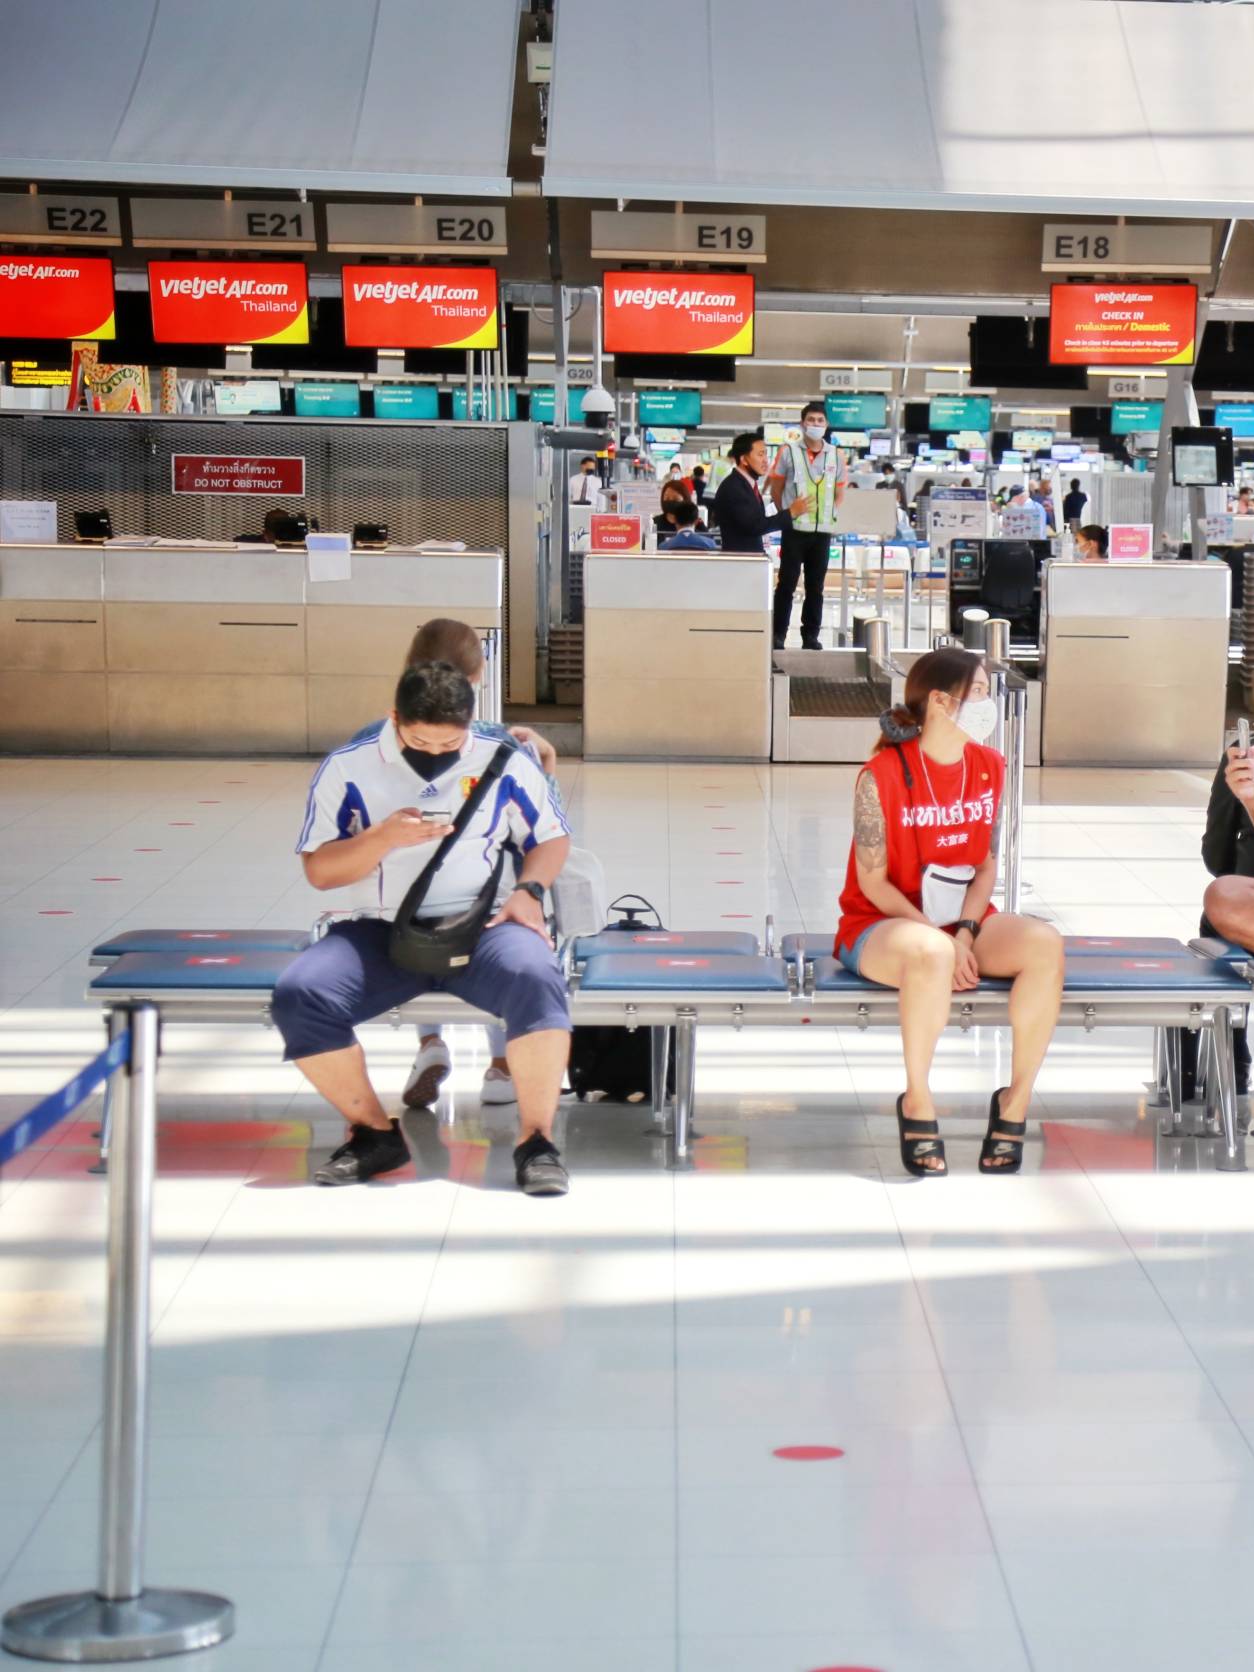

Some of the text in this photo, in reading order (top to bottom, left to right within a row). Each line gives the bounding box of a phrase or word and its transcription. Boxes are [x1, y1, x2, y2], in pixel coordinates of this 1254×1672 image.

[47, 208, 108, 232] E22
[246, 212, 302, 236] E21
[436, 218, 494, 242] E20
[697, 225, 754, 250] E19
[1056, 236, 1110, 258] E18
[240, 300, 297, 312] Thailand
[432, 304, 487, 318] Thailand
[689, 310, 743, 324] Thailand
[1102, 312, 1144, 320] CHECK IN
[1130, 322, 1170, 332] Domestic
[568, 368, 593, 380] G20
[825, 374, 850, 385] G18
[1114, 383, 1138, 392] G16
[194, 479, 208, 487] DO
[233, 480, 282, 488] OBSTRUCT
